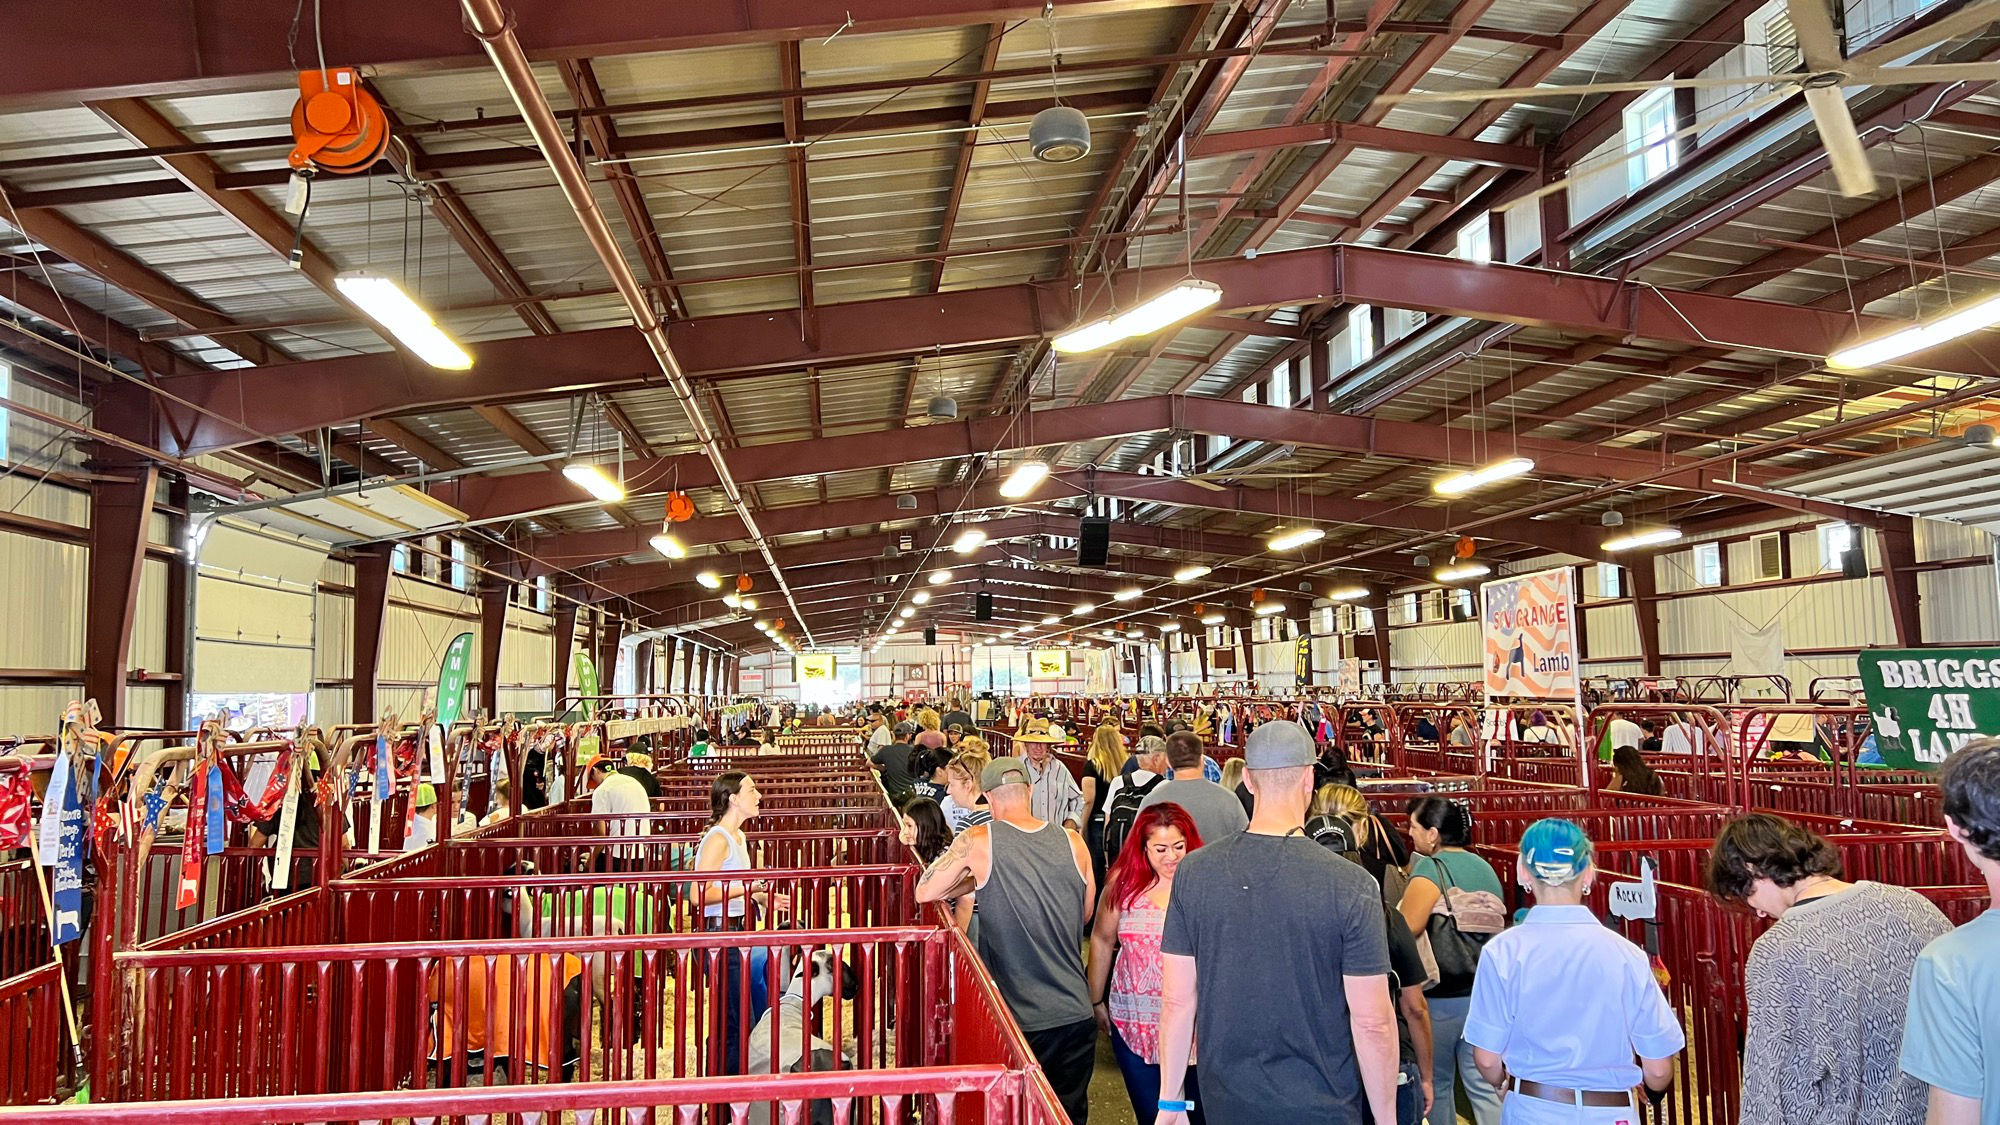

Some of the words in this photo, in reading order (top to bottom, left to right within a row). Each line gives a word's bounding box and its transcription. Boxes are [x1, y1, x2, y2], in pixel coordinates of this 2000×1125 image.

[1515, 602, 1567, 628] GRANGE
[1533, 652, 1569, 673] Lamb
[1928, 693, 1976, 729] 4H
[1615, 886, 1643, 904] ROCKY
